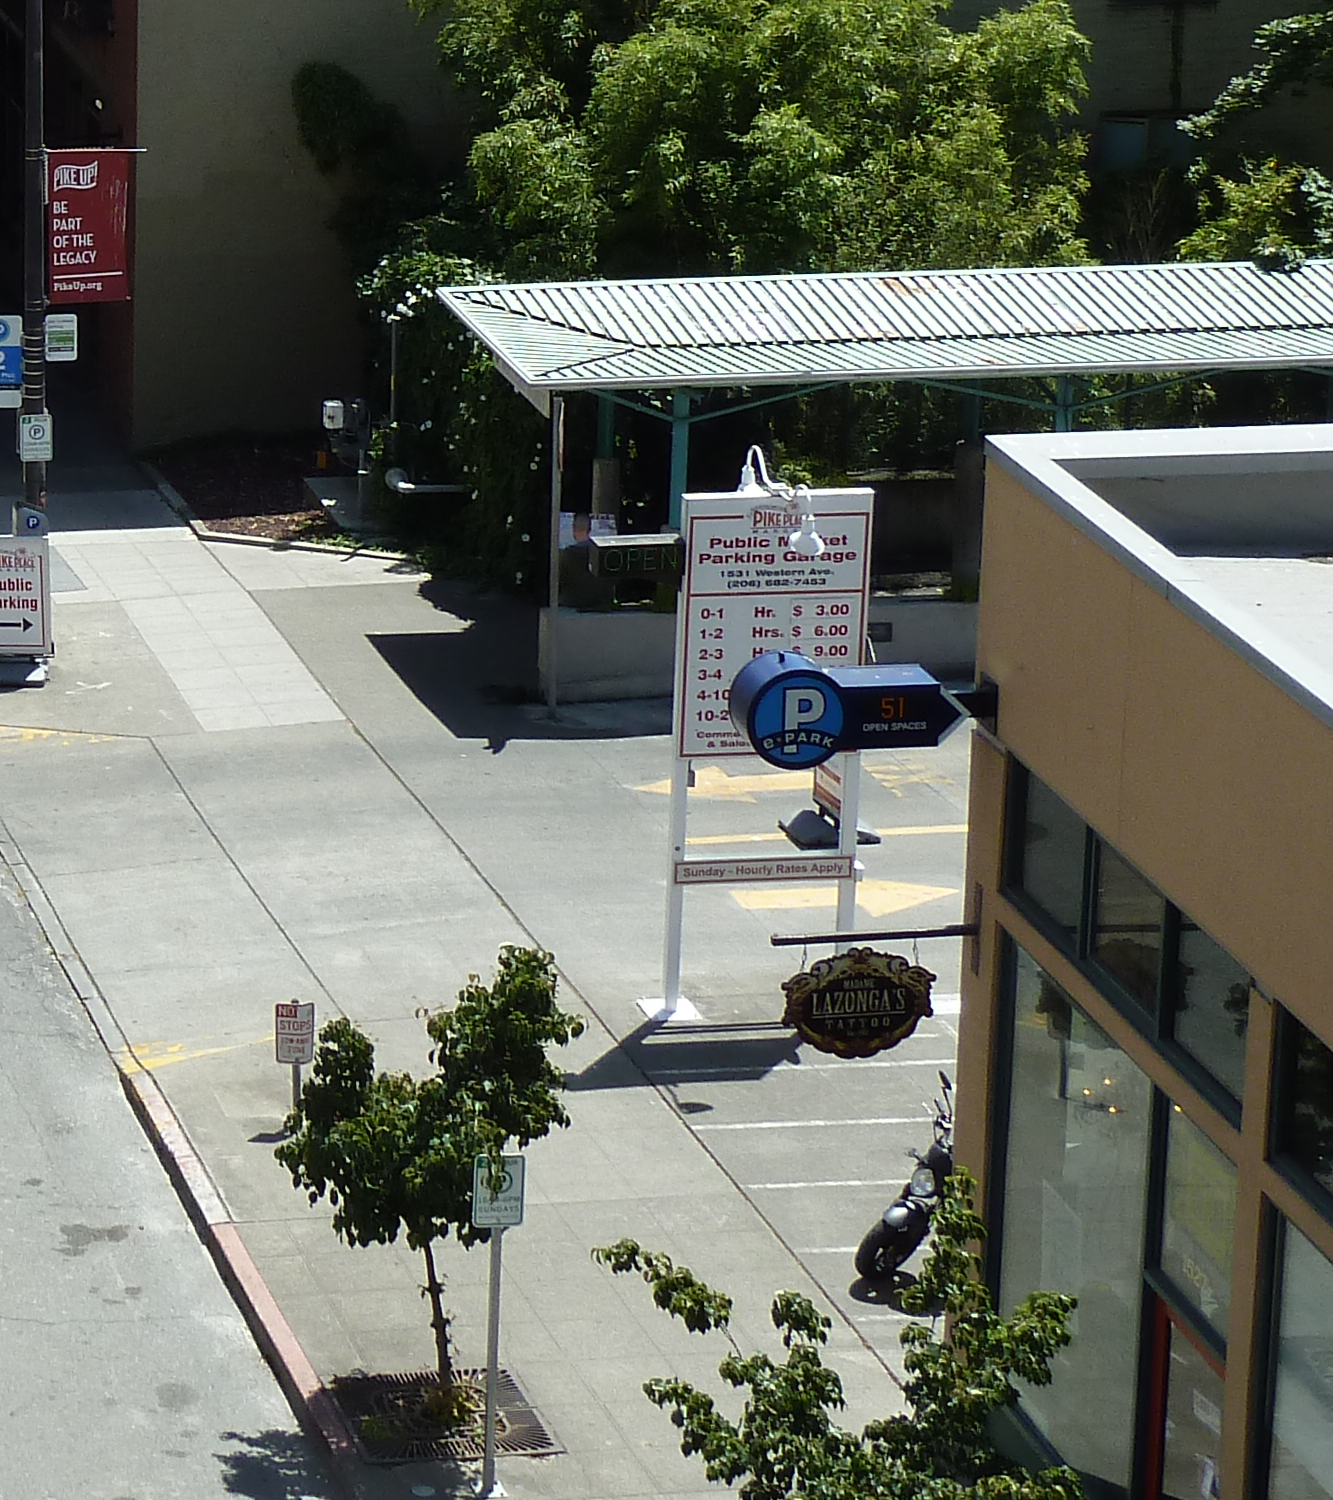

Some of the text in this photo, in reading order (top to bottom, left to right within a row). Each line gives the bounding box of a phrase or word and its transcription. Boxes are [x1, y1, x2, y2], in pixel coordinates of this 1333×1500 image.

[54, 163, 98, 186] PIKE UP!
[53, 201, 68, 214] BE
[53, 217, 82, 231] PART
[53, 234, 94, 248] OF THE
[53, 251, 97, 265] LEGACY
[753, 510, 802, 527] PIKE PLA
[710, 534, 848, 548] Public Mket
[603, 547, 678, 572] OPEN
[699, 550, 858, 566] Parking Garage
[720, 567, 835, 578] 1531 Western Ave.
[727, 579, 761, 589] (206)
[700, 604, 850, 620] 0-1 Hr. $ 3.00
[699, 625, 849, 640] 1-2 Hrs. $ 6.00
[699, 648, 724, 660] 2-3
[814, 645, 849, 657] 9.00
[698, 669, 723, 680] 3-4
[696, 689, 730, 701] 4-10
[696, 709, 729, 722] 10-2
[880, 698, 905, 719] 51
[862, 721, 927, 732] OPEN SPACES
[683, 866, 726, 878] Sunday
[735, 865, 773, 877] Hourly
[776, 864, 808, 874] Rates
[811, 863, 844, 875] Apply
[812, 987, 906, 1015] LAZONGA'S
[278, 1005, 295, 1016] NO
[279, 1019, 312, 1031] STOPS
[825, 1017, 891, 1029] TATTOO
[478, 1205, 520, 1213] SUNDAYS
